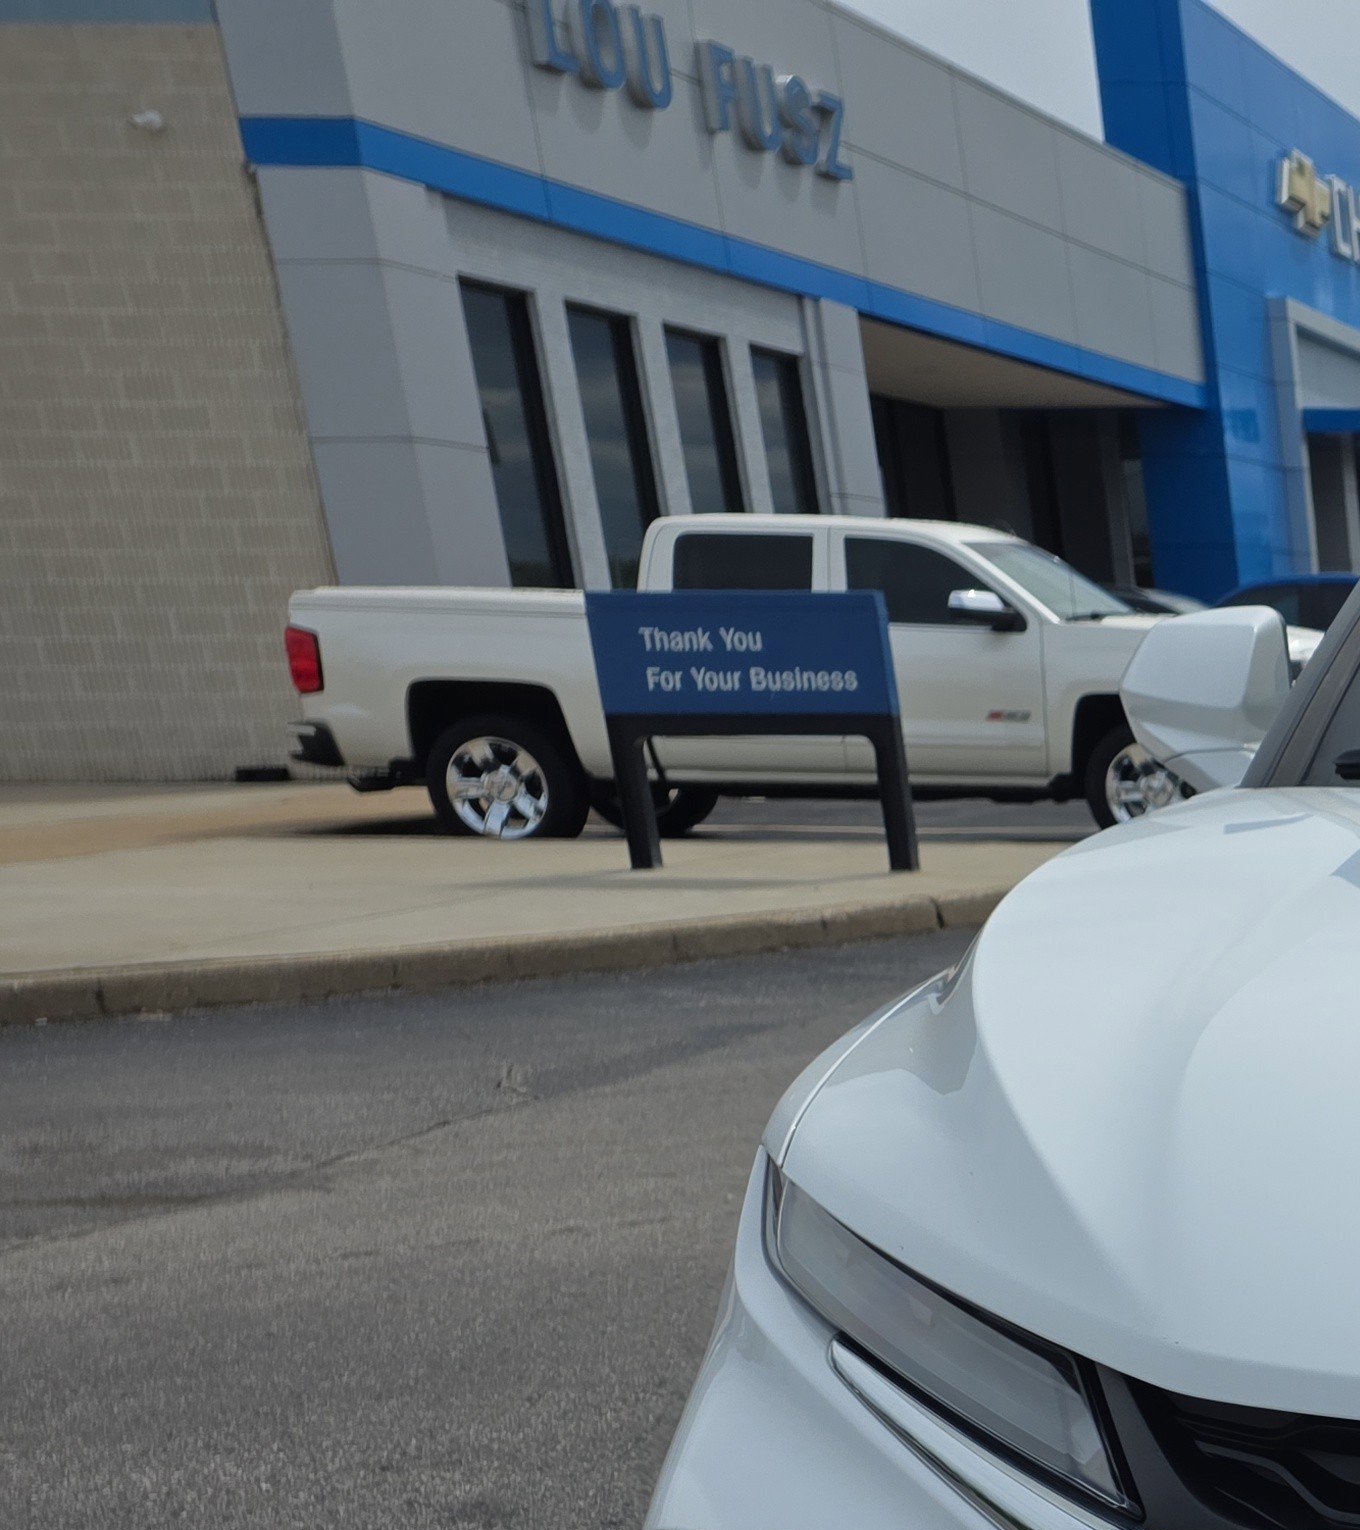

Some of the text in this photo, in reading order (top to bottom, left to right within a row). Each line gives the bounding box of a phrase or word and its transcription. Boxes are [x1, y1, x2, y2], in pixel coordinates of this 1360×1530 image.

[531, 0, 673, 109] LOU
[637, 626, 763, 652] Thank You
[645, 666, 859, 692] For Your Business
